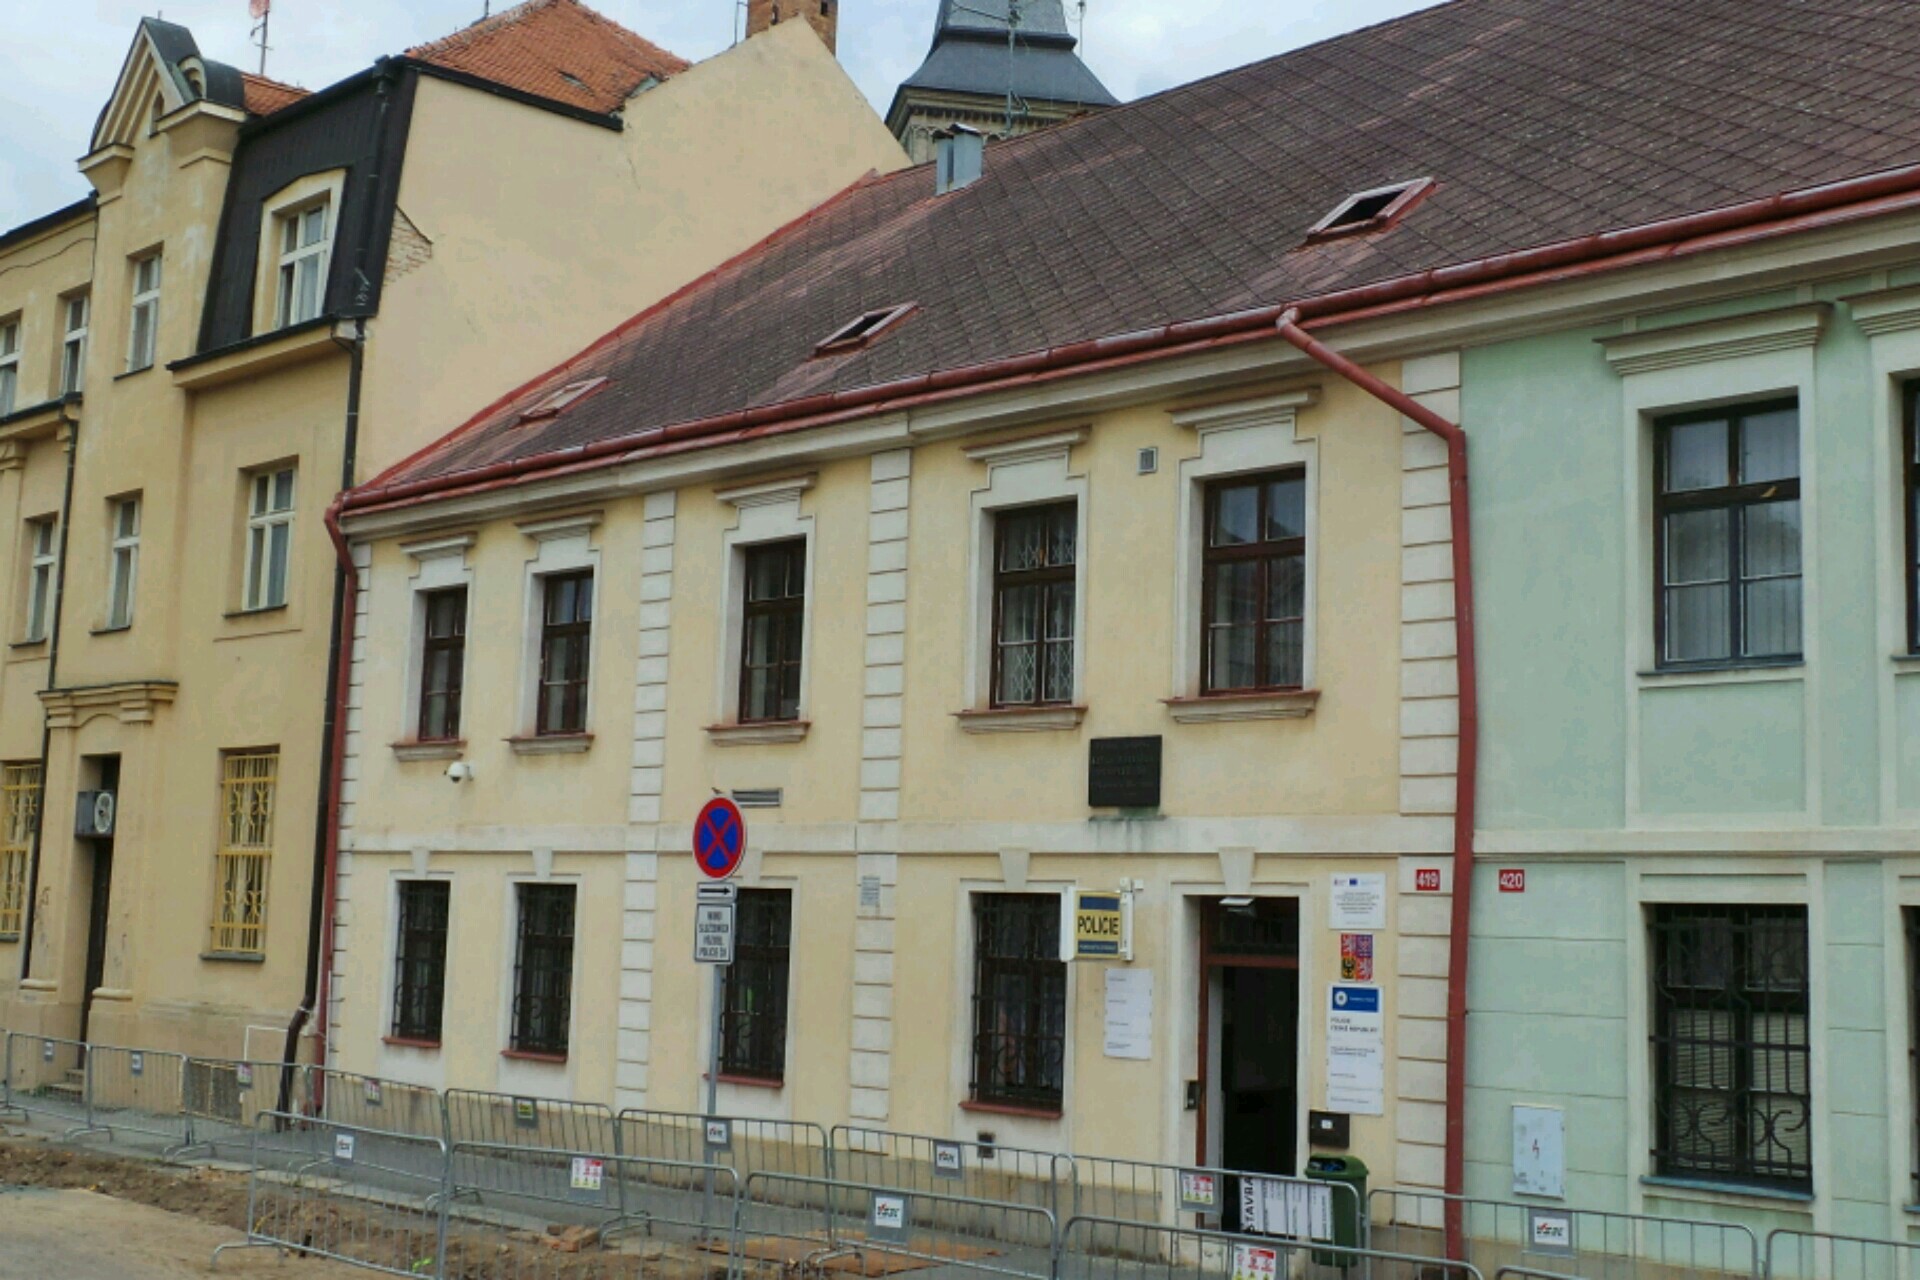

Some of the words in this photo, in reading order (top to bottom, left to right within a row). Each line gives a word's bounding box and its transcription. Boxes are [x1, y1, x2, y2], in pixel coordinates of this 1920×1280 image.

[1416, 872, 1438, 887] 419
[1500, 873, 1523, 888] 420
[1077, 915, 1119, 935] POLICIE
